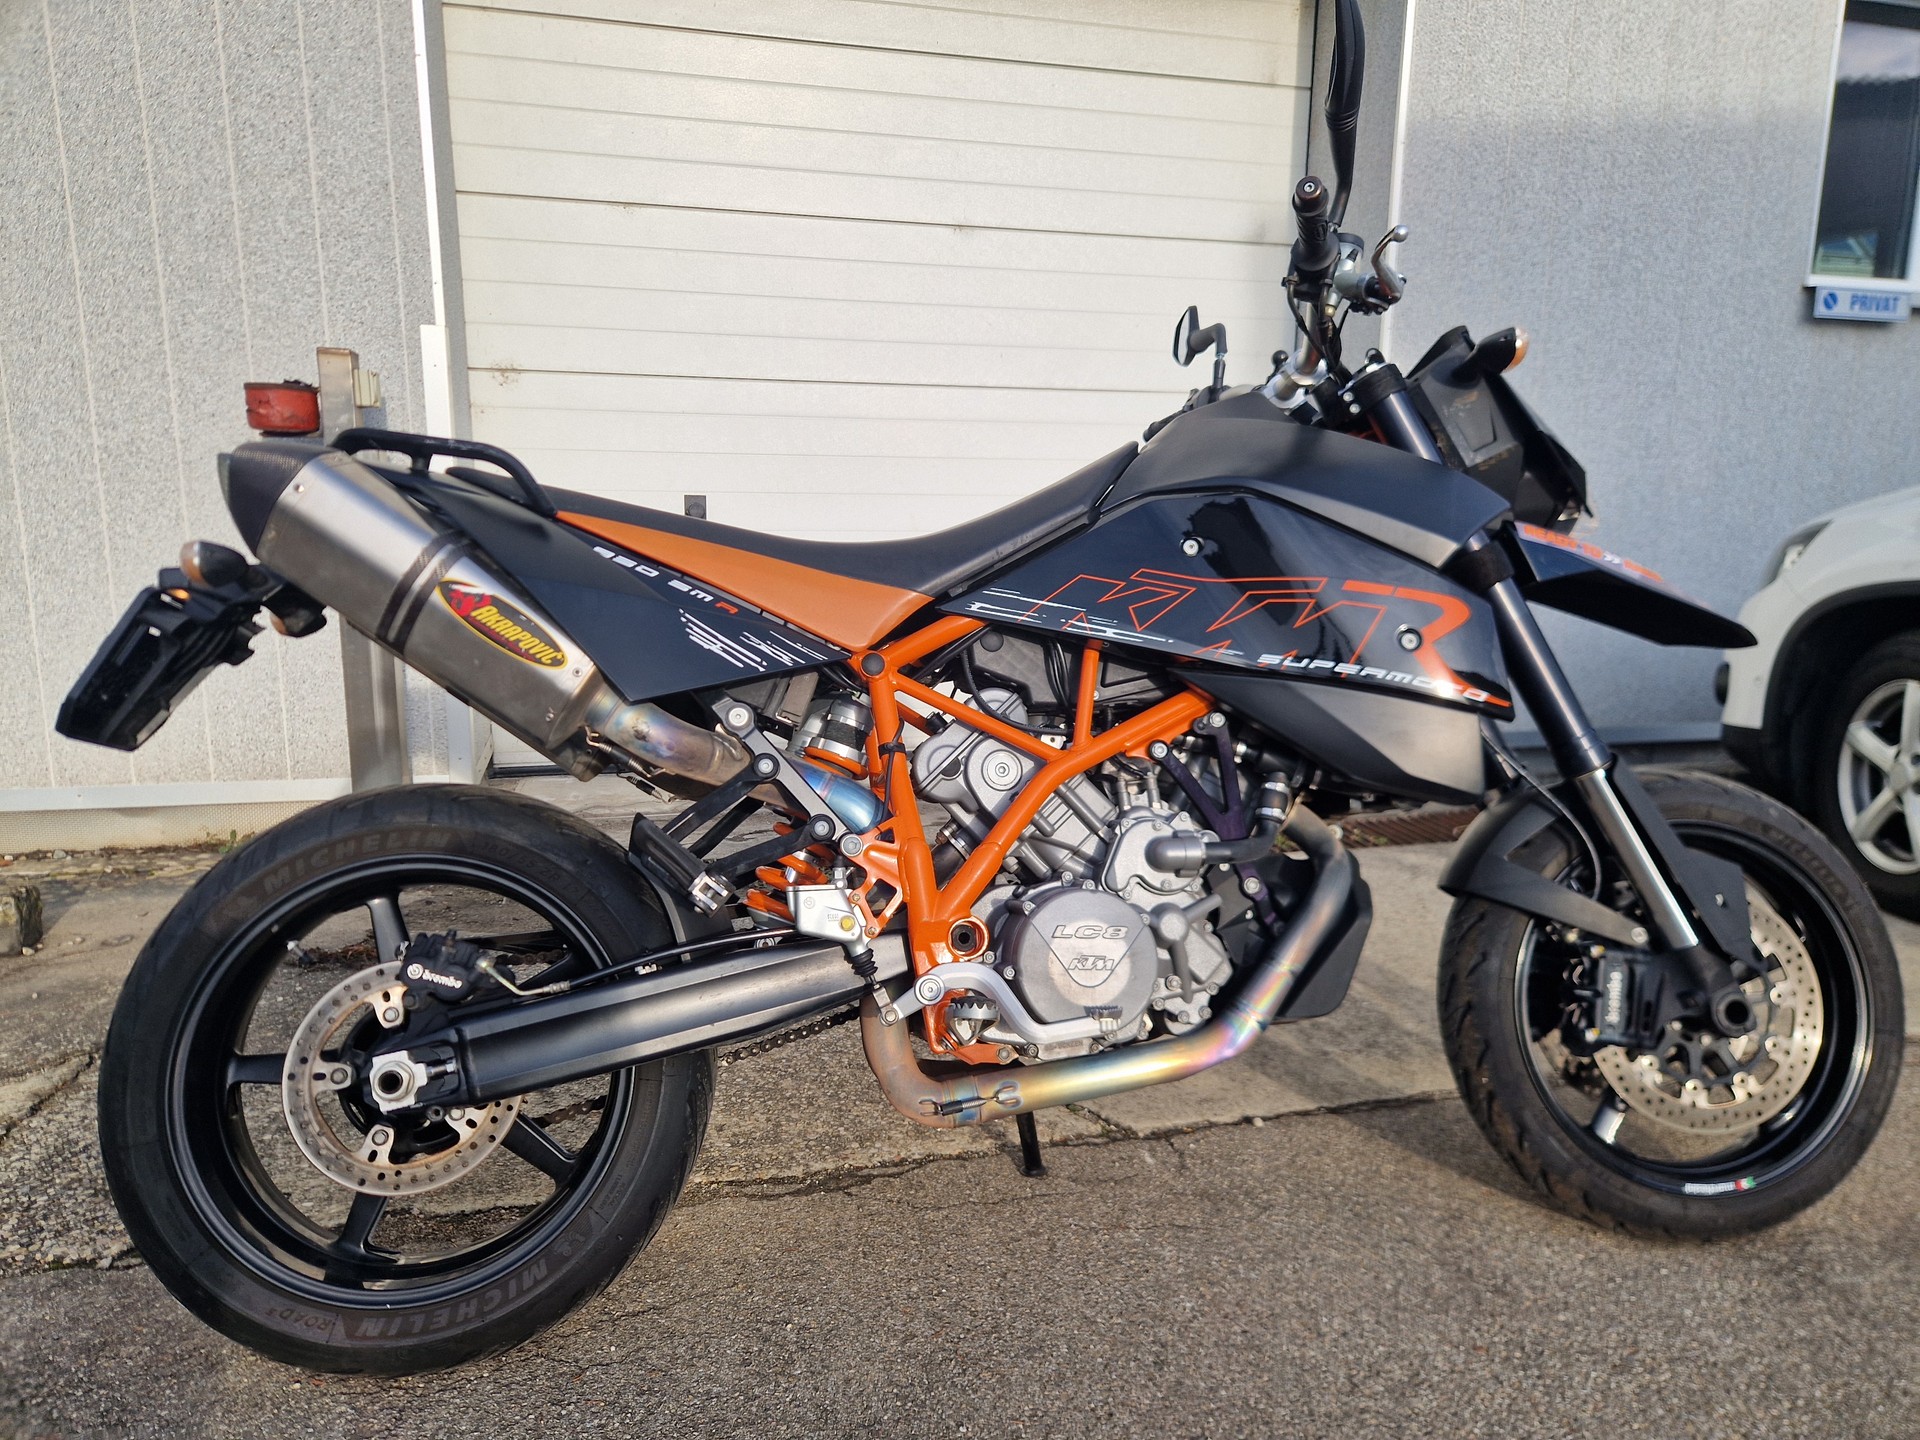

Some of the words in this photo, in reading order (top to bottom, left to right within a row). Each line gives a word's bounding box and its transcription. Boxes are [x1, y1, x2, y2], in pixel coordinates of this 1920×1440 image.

[1849, 293, 1900, 312] PRIVAT
[667, 579, 714, 602] SM
[715, 601, 739, 614] R
[263, 831, 450, 895] MICHELIN
[1051, 924, 1129, 940] LC8
[1067, 954, 1116, 971] KTM
[355, 1258, 548, 1337] MICHELIN
